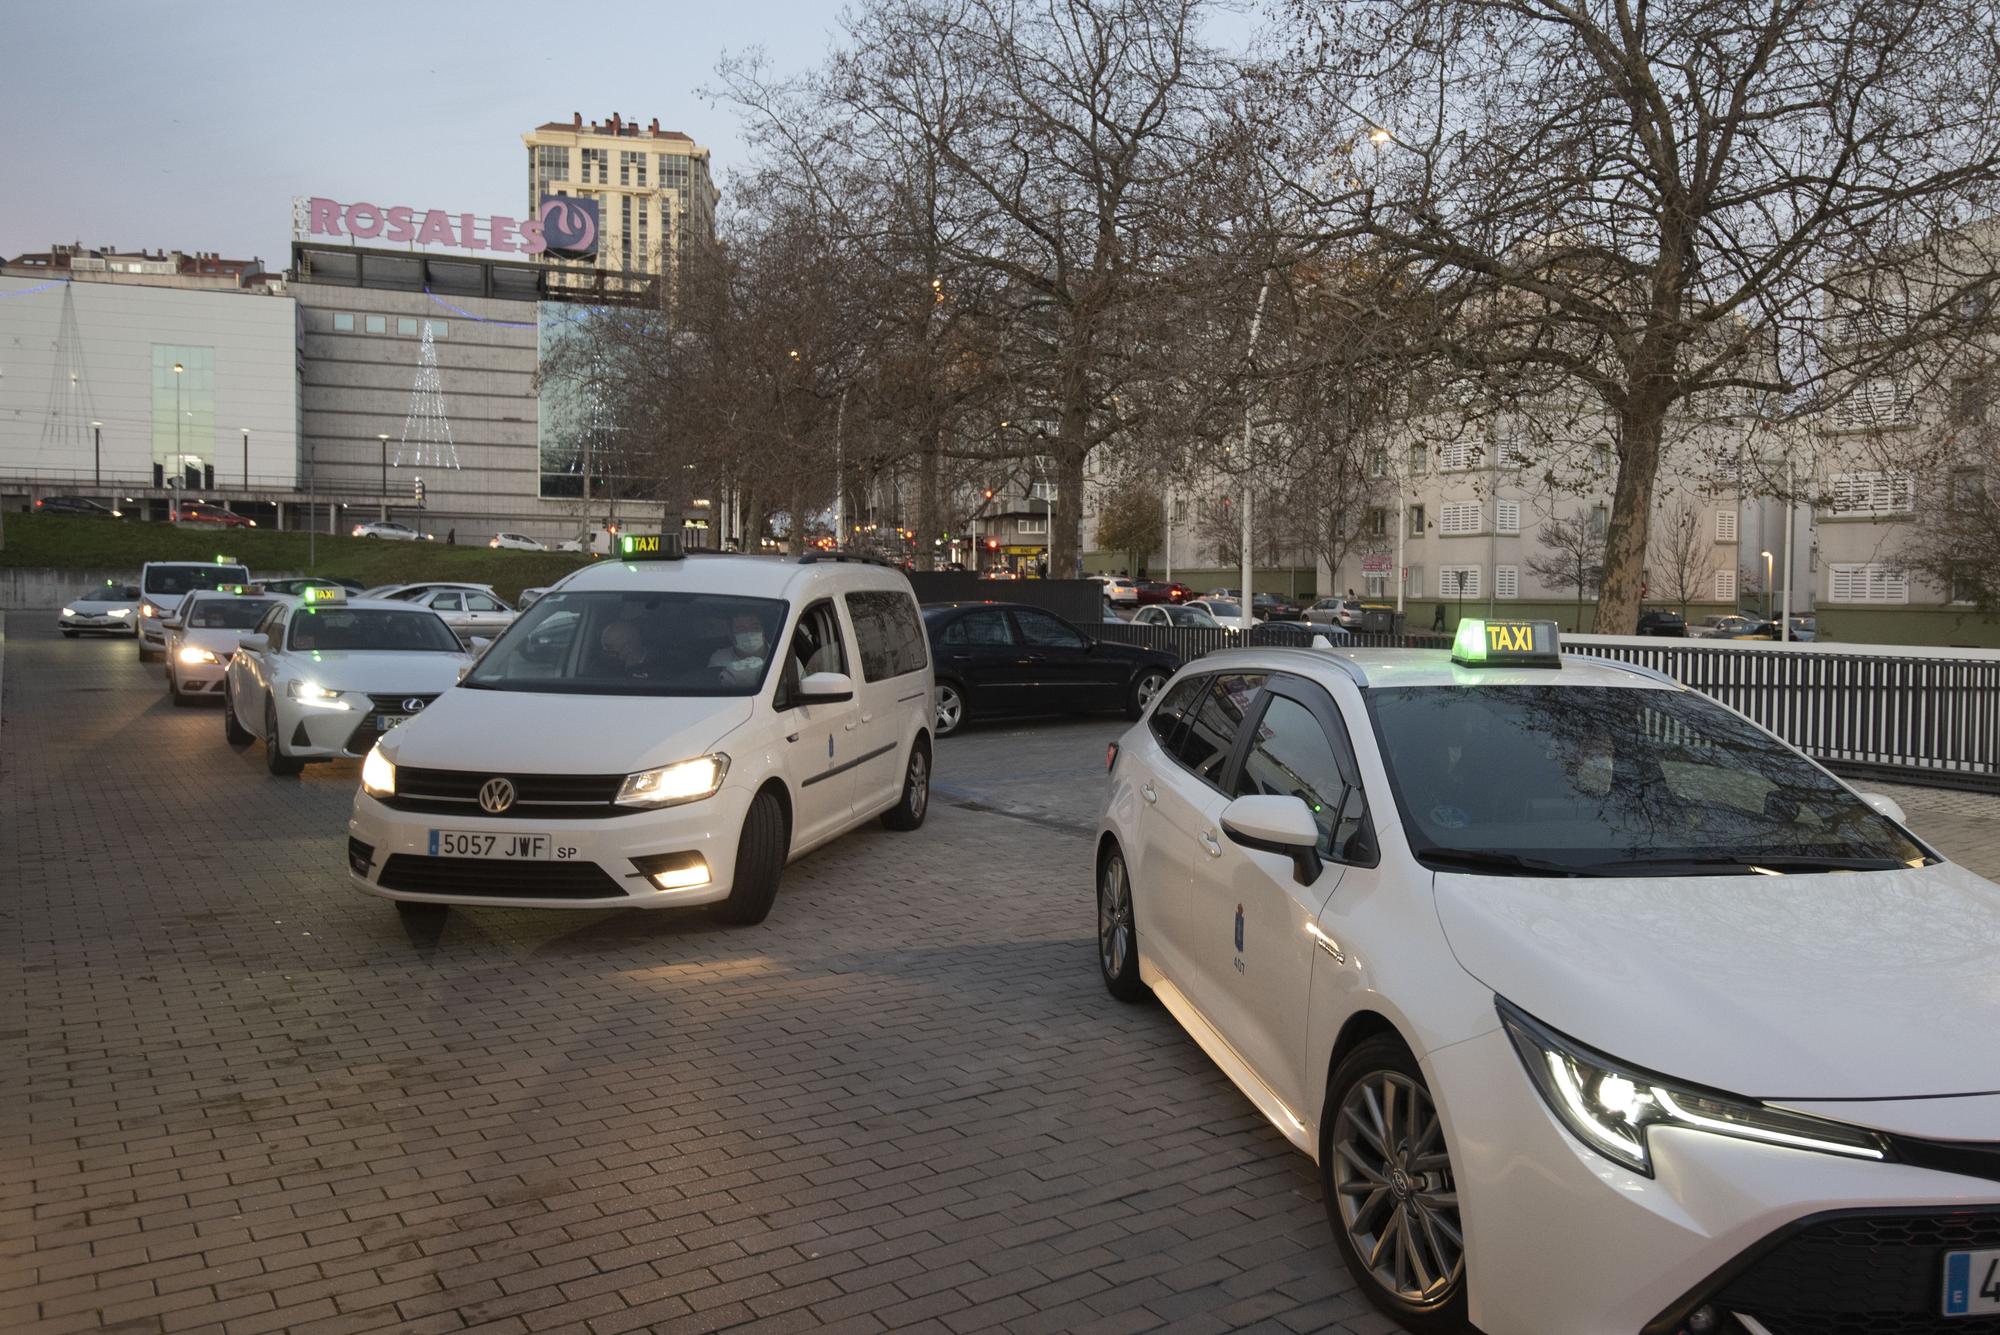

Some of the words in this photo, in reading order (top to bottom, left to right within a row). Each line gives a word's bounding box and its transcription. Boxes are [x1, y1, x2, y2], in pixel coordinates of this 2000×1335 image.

[310, 196, 547, 254] ROSALES
[634, 536, 659, 552] TAXI
[315, 589, 336, 600] TAXI
[1487, 625, 1533, 651] TAXI
[443, 834, 496, 857] 5057
[505, 837, 546, 858] JWF
[557, 847, 577, 859] SP
